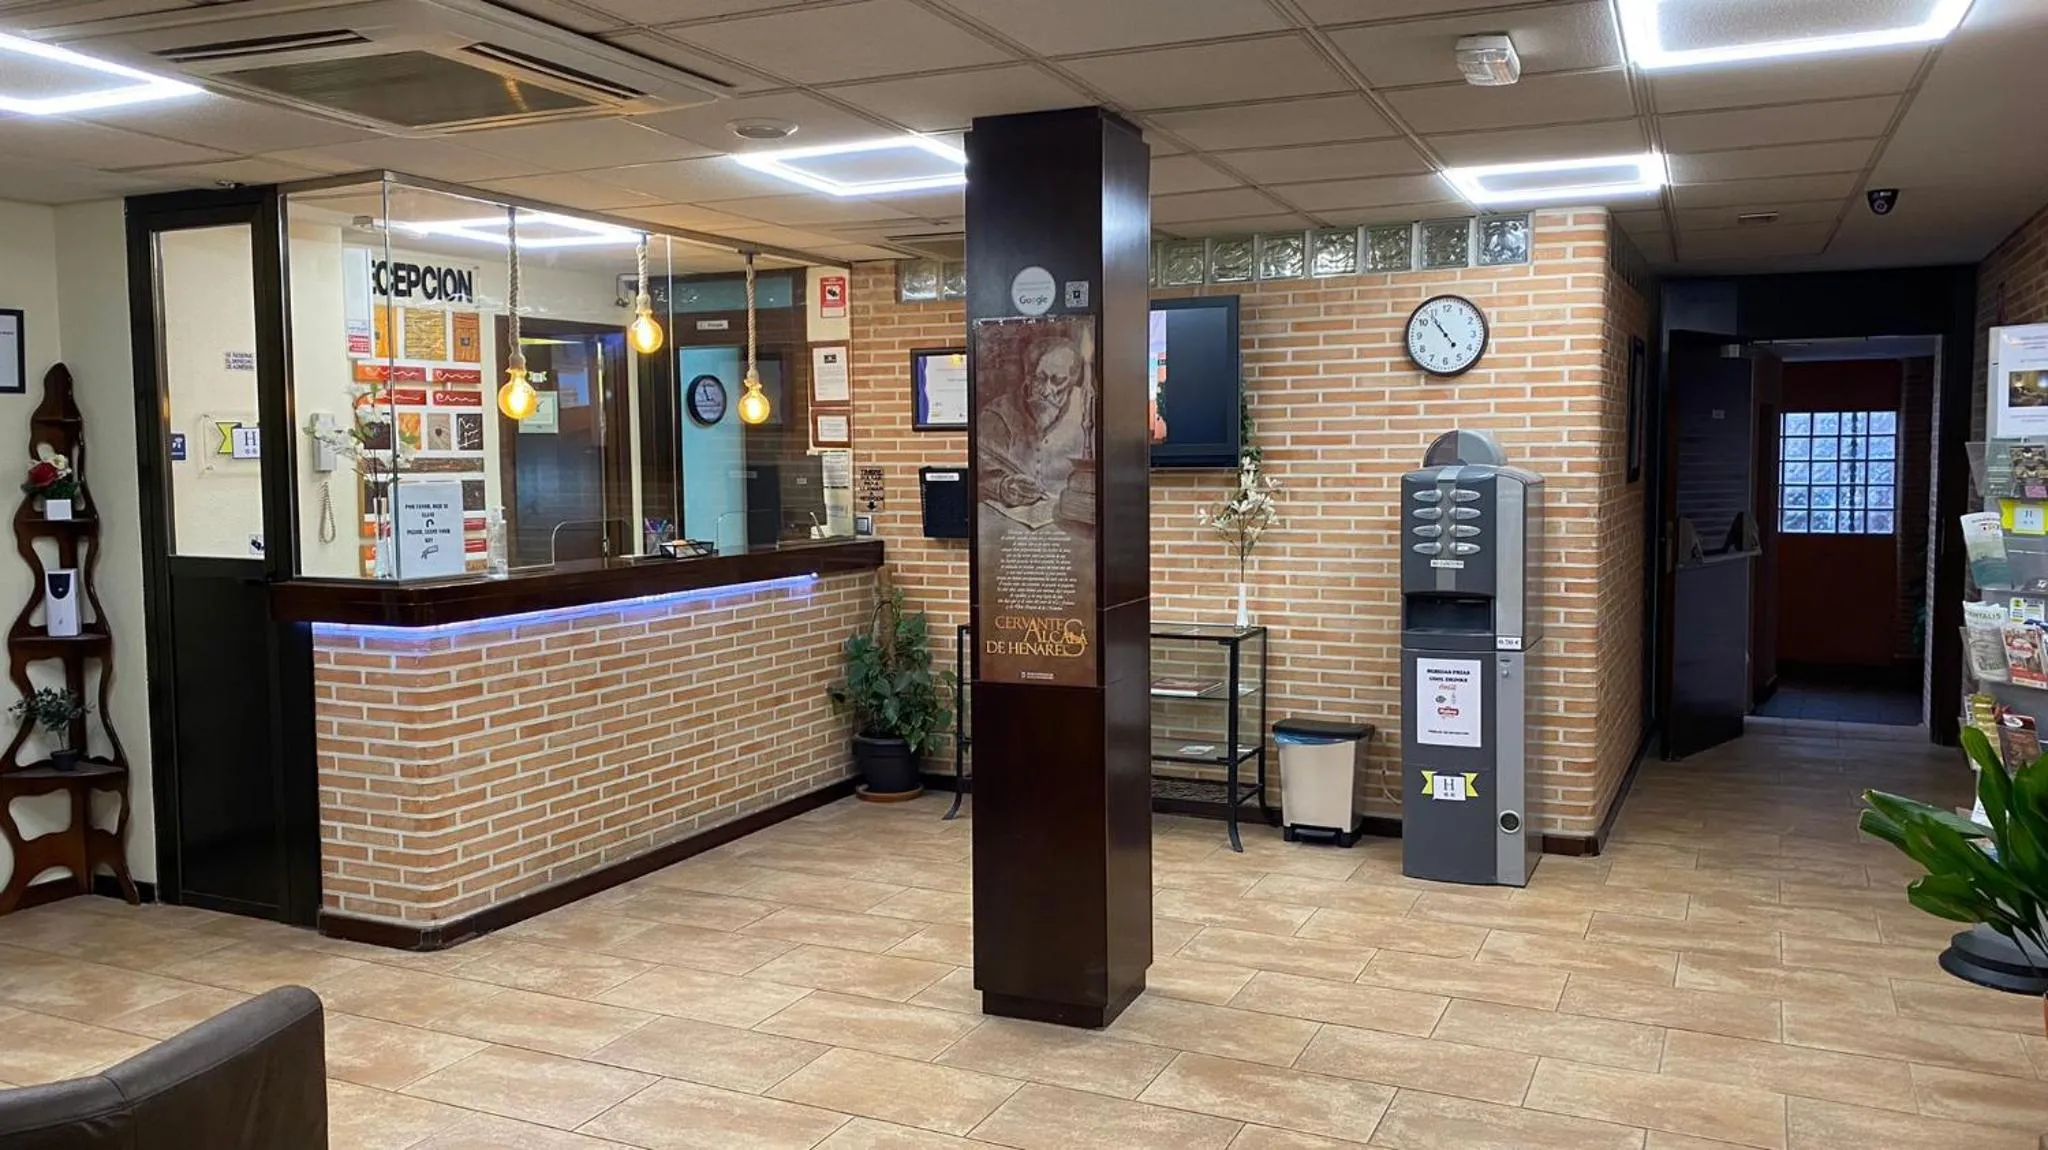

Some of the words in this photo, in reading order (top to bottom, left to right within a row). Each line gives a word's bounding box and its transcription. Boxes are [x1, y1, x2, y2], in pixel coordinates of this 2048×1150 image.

[1019, 294, 1048, 305] Google
[244, 431, 257, 446] H
[986, 640, 1005, 655] DE
[1443, 778, 1454, 790] H
